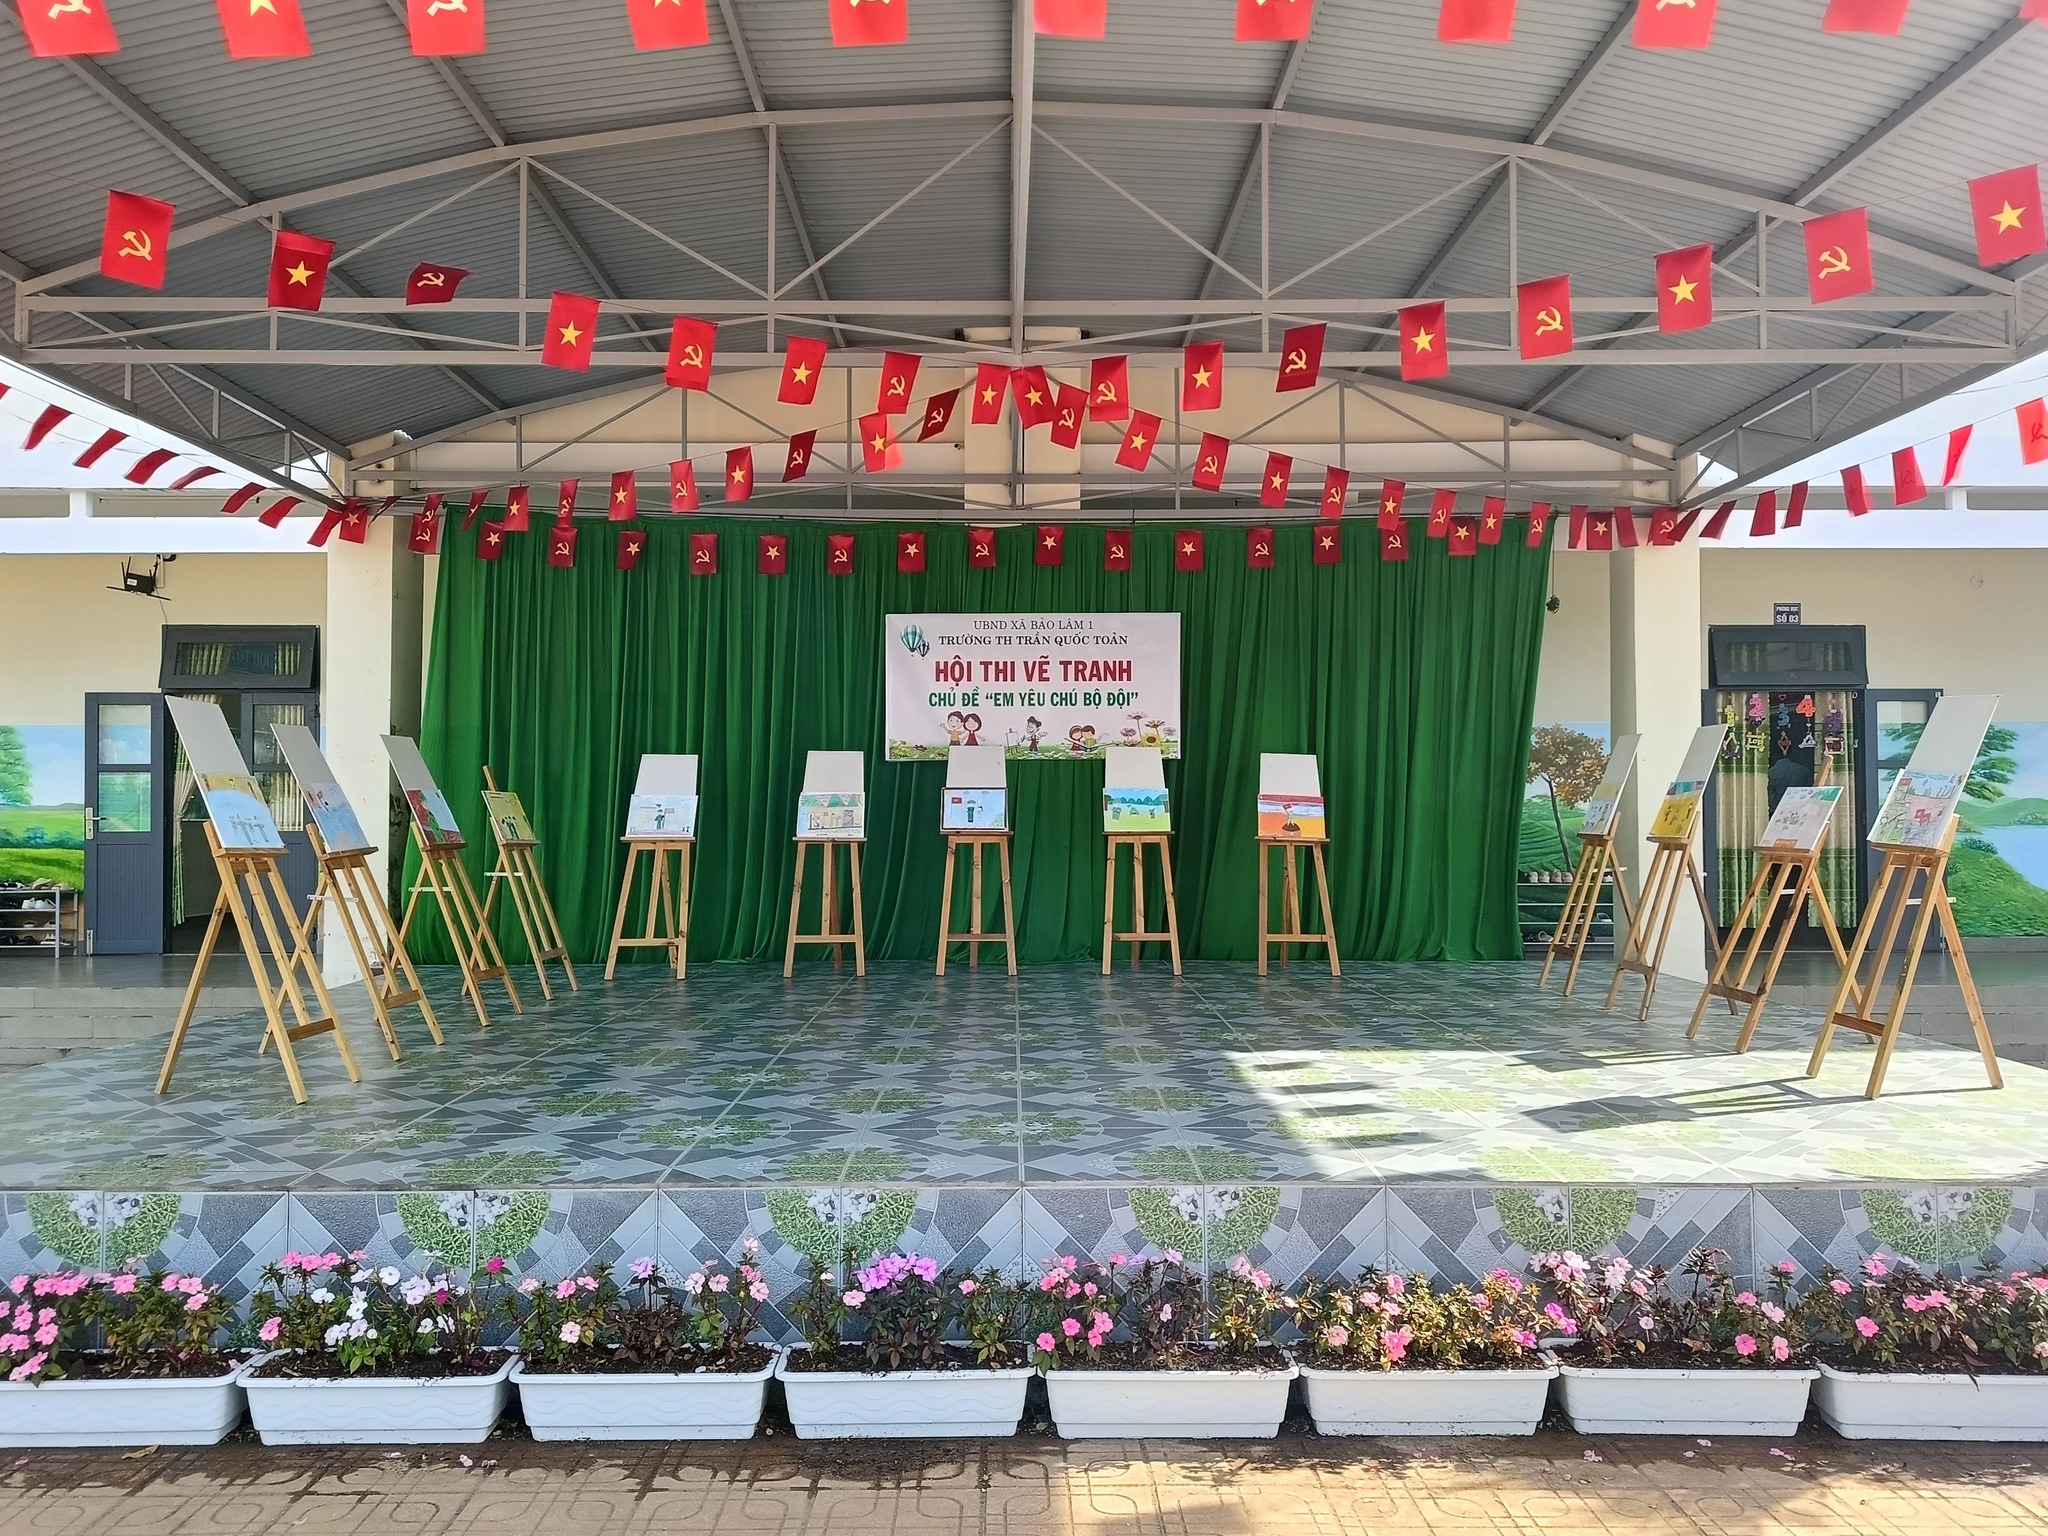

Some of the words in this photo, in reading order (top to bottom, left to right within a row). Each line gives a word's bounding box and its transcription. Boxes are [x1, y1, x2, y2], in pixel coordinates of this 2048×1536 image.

[974, 621, 1007, 630] UBND
[1011, 619, 1026, 629] XÃ
[1031, 618, 1054, 629] BẢO
[1059, 618, 1083, 629] LÂM
[1088, 621, 1093, 629] 1
[1776, 612, 1787, 622] SỐ
[939, 632, 991, 645] TRƯỜNG
[996, 636, 1011, 645] TH
[1016, 632, 1050, 645] TRẦN
[1055, 632, 1089, 646] QUỐC
[1094, 631, 1127, 645] TOẢN
[935, 655, 972, 686] HỘI
[980, 661, 1015, 682] THI
[1023, 655, 1050, 682] VẼ
[1059, 660, 1131, 682] TRANH
[929, 687, 956, 707] CHỦ
[961, 686, 979, 706] ĐỀ
[1018, 689, 1045, 706] YÊU
[1051, 689, 1077, 706] CHÚ
[1084, 689, 1101, 709] BỘ
